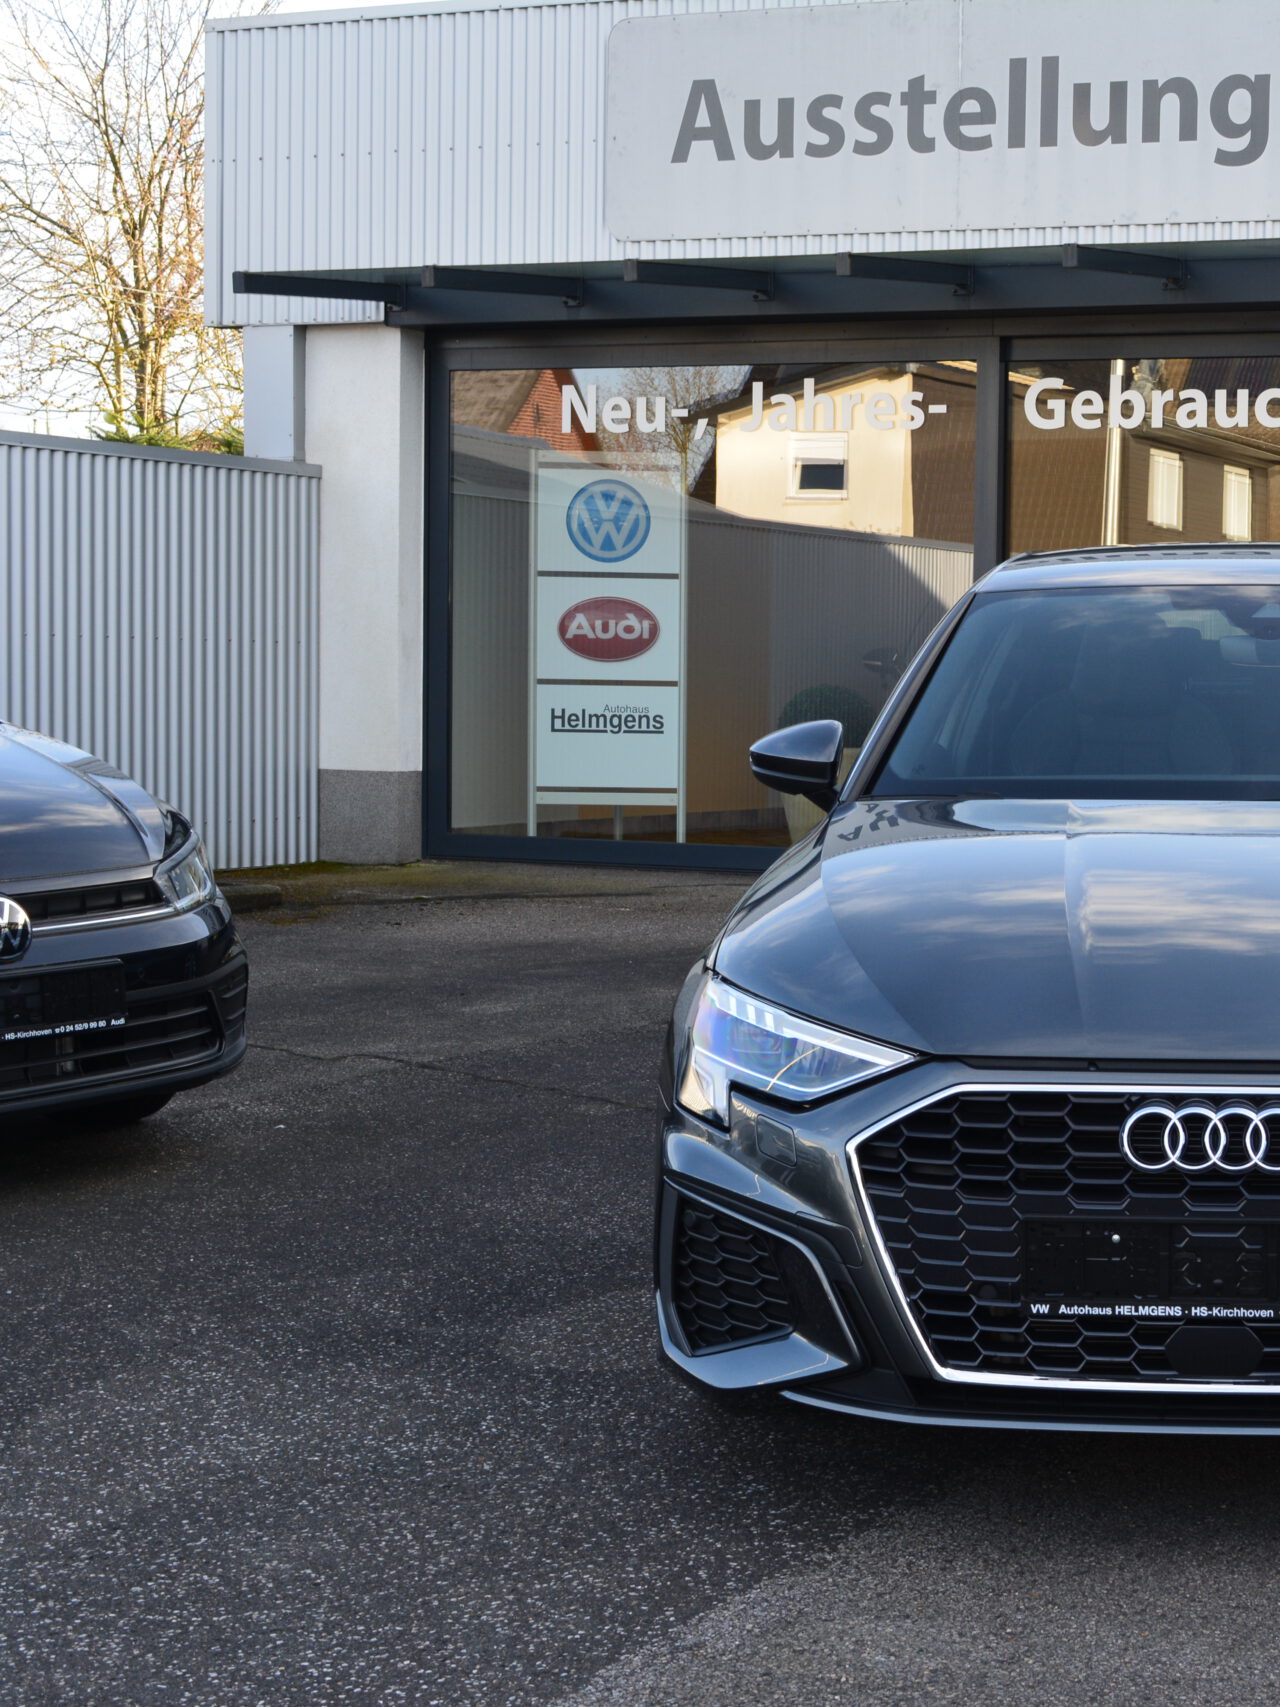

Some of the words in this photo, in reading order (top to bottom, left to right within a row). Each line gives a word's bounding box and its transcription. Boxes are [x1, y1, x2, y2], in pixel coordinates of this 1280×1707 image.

[670, 55, 1272, 167] Ausstellung
[560, 384, 708, 440] Neu-,
[740, 378, 948, 431] Jahres-
[565, 613, 654, 640] Audi
[551, 708, 664, 734] Helmgens
[603, 704, 650, 714] Autohaus
[110, 1018, 126, 1026] Audi
[1030, 1304, 1050, 1314] VW
[1058, 1304, 1112, 1315] Autohaus
[1115, 1305, 1182, 1316] HELMGENS
[1191, 1306, 1274, 1318] HS-Kirchhoven
